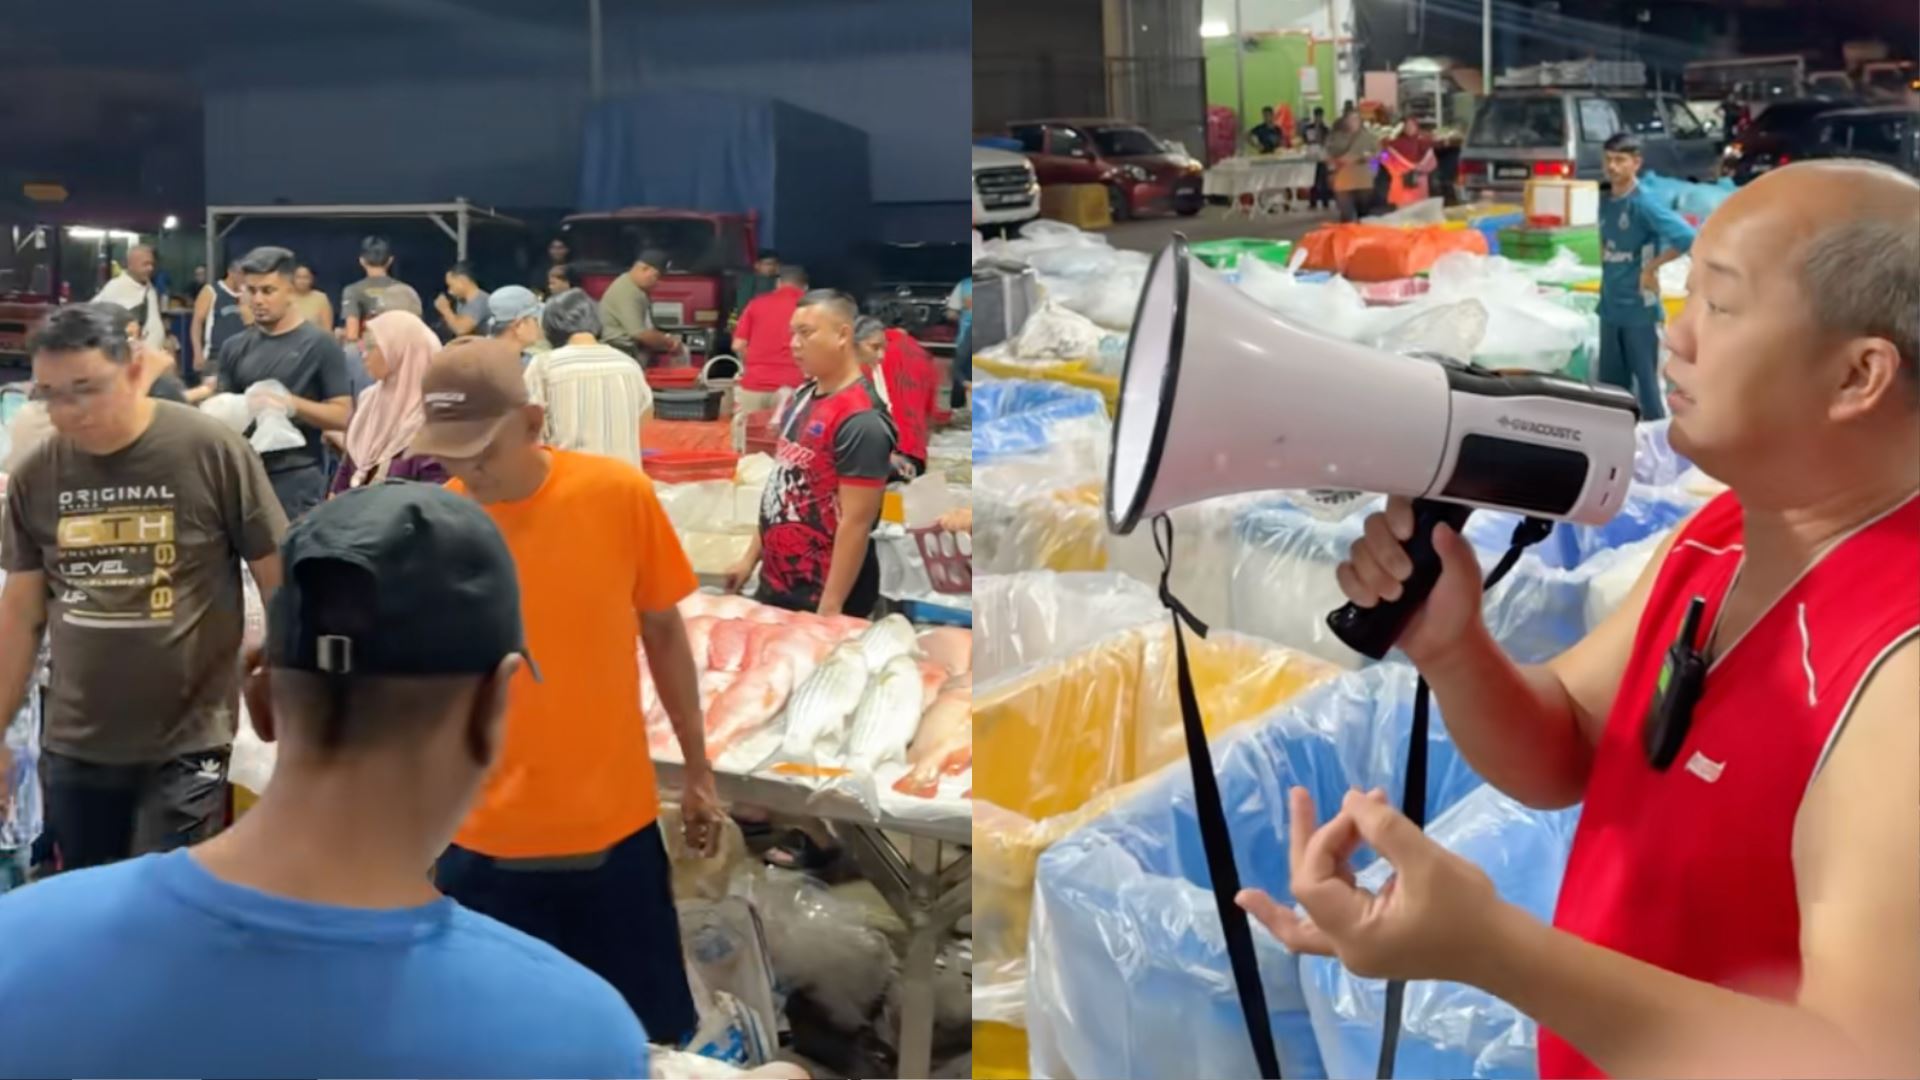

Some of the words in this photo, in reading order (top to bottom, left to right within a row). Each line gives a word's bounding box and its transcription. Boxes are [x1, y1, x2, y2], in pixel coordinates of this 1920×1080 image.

[58, 485, 175, 504] ORIGINAL
[65, 515, 167, 543] CTH
[59, 559, 128, 575] LEVEL
[61, 590, 88, 604] UP
